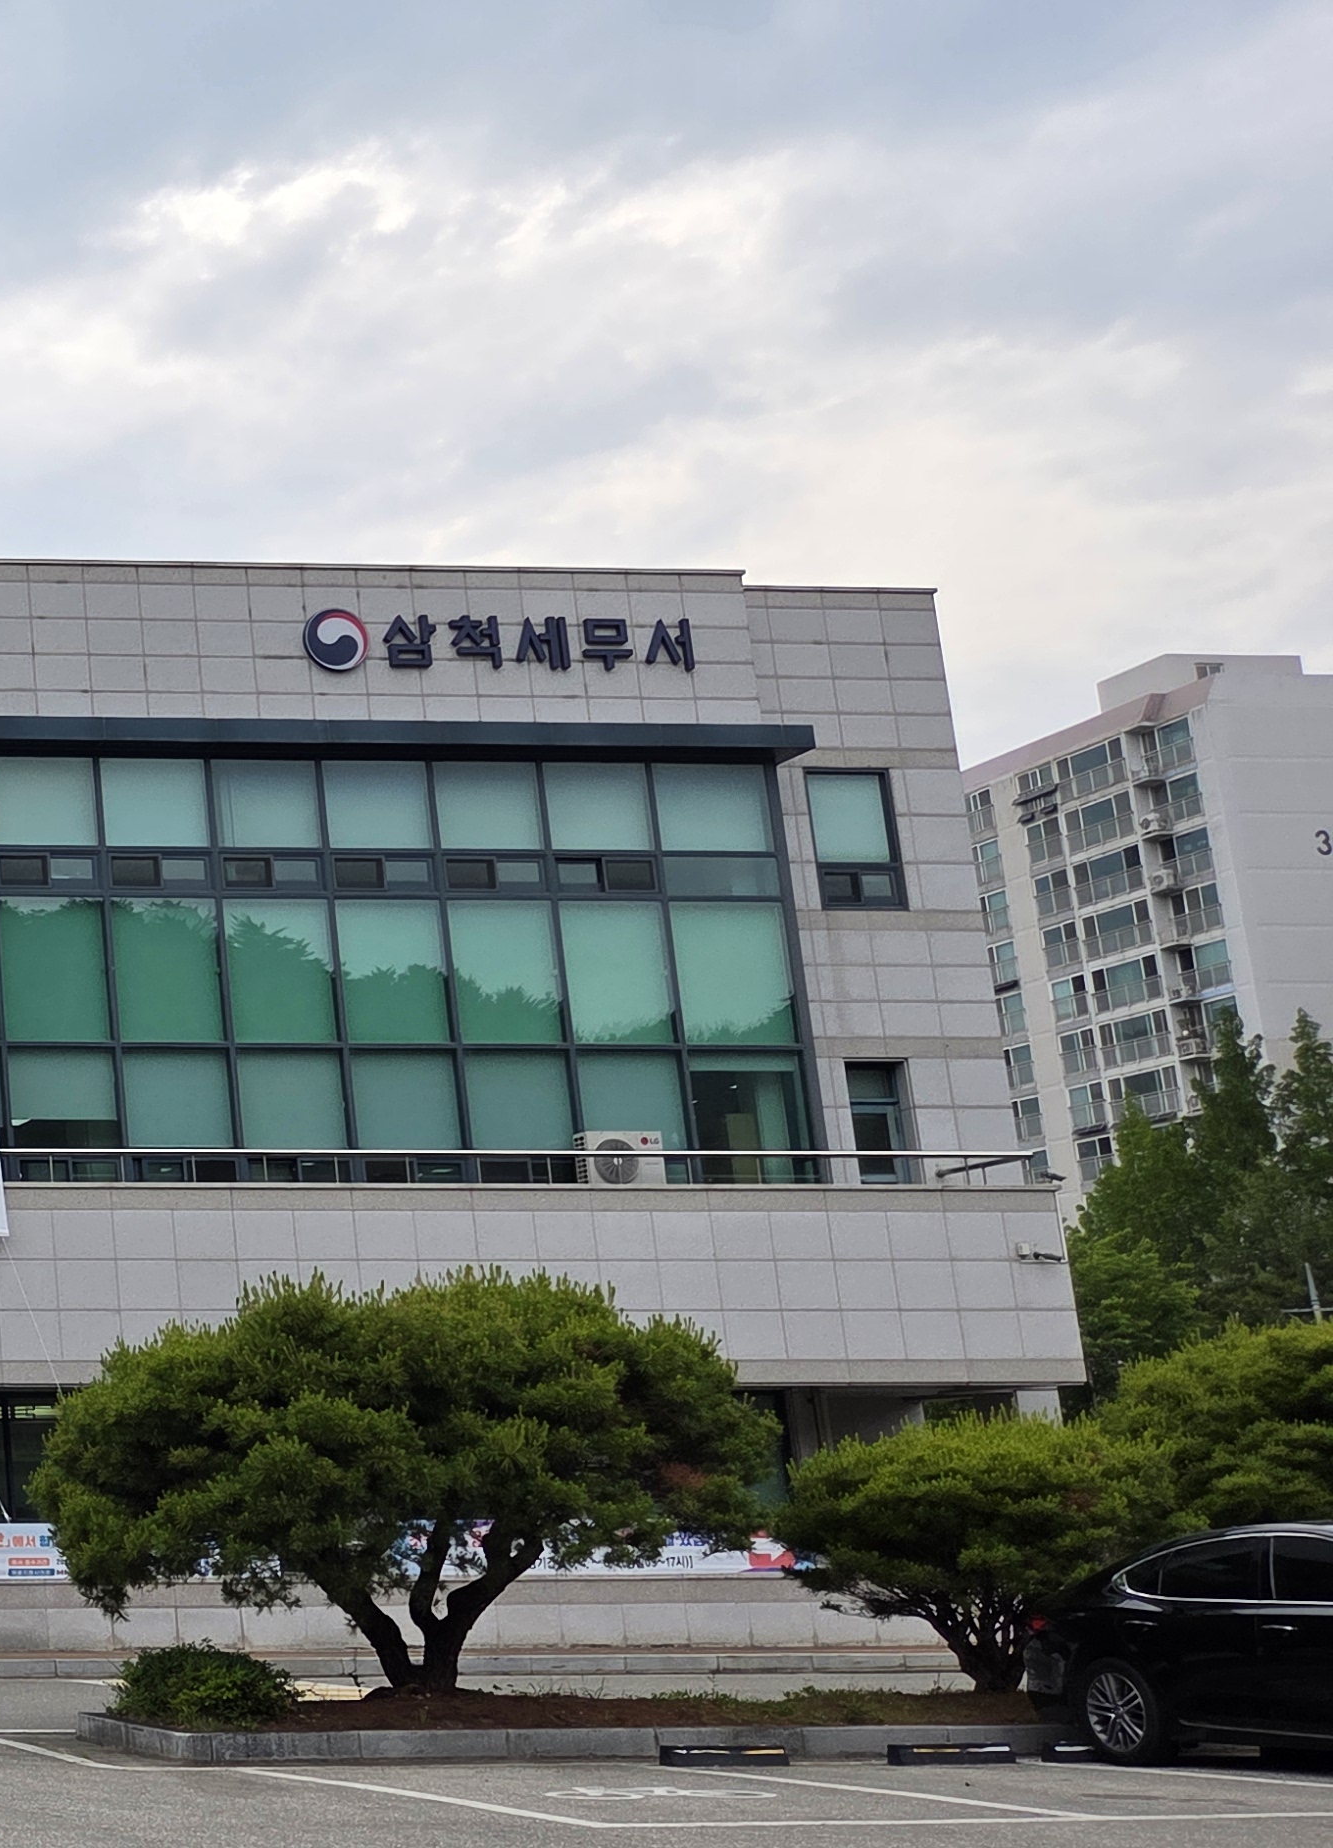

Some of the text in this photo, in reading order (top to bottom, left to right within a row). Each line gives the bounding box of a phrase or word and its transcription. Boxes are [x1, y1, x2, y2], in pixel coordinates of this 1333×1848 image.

[382, 613, 696, 673] 삼척세무서
[1314, 829, 1333, 856] 3
[649, 1137, 660, 1145] LG
